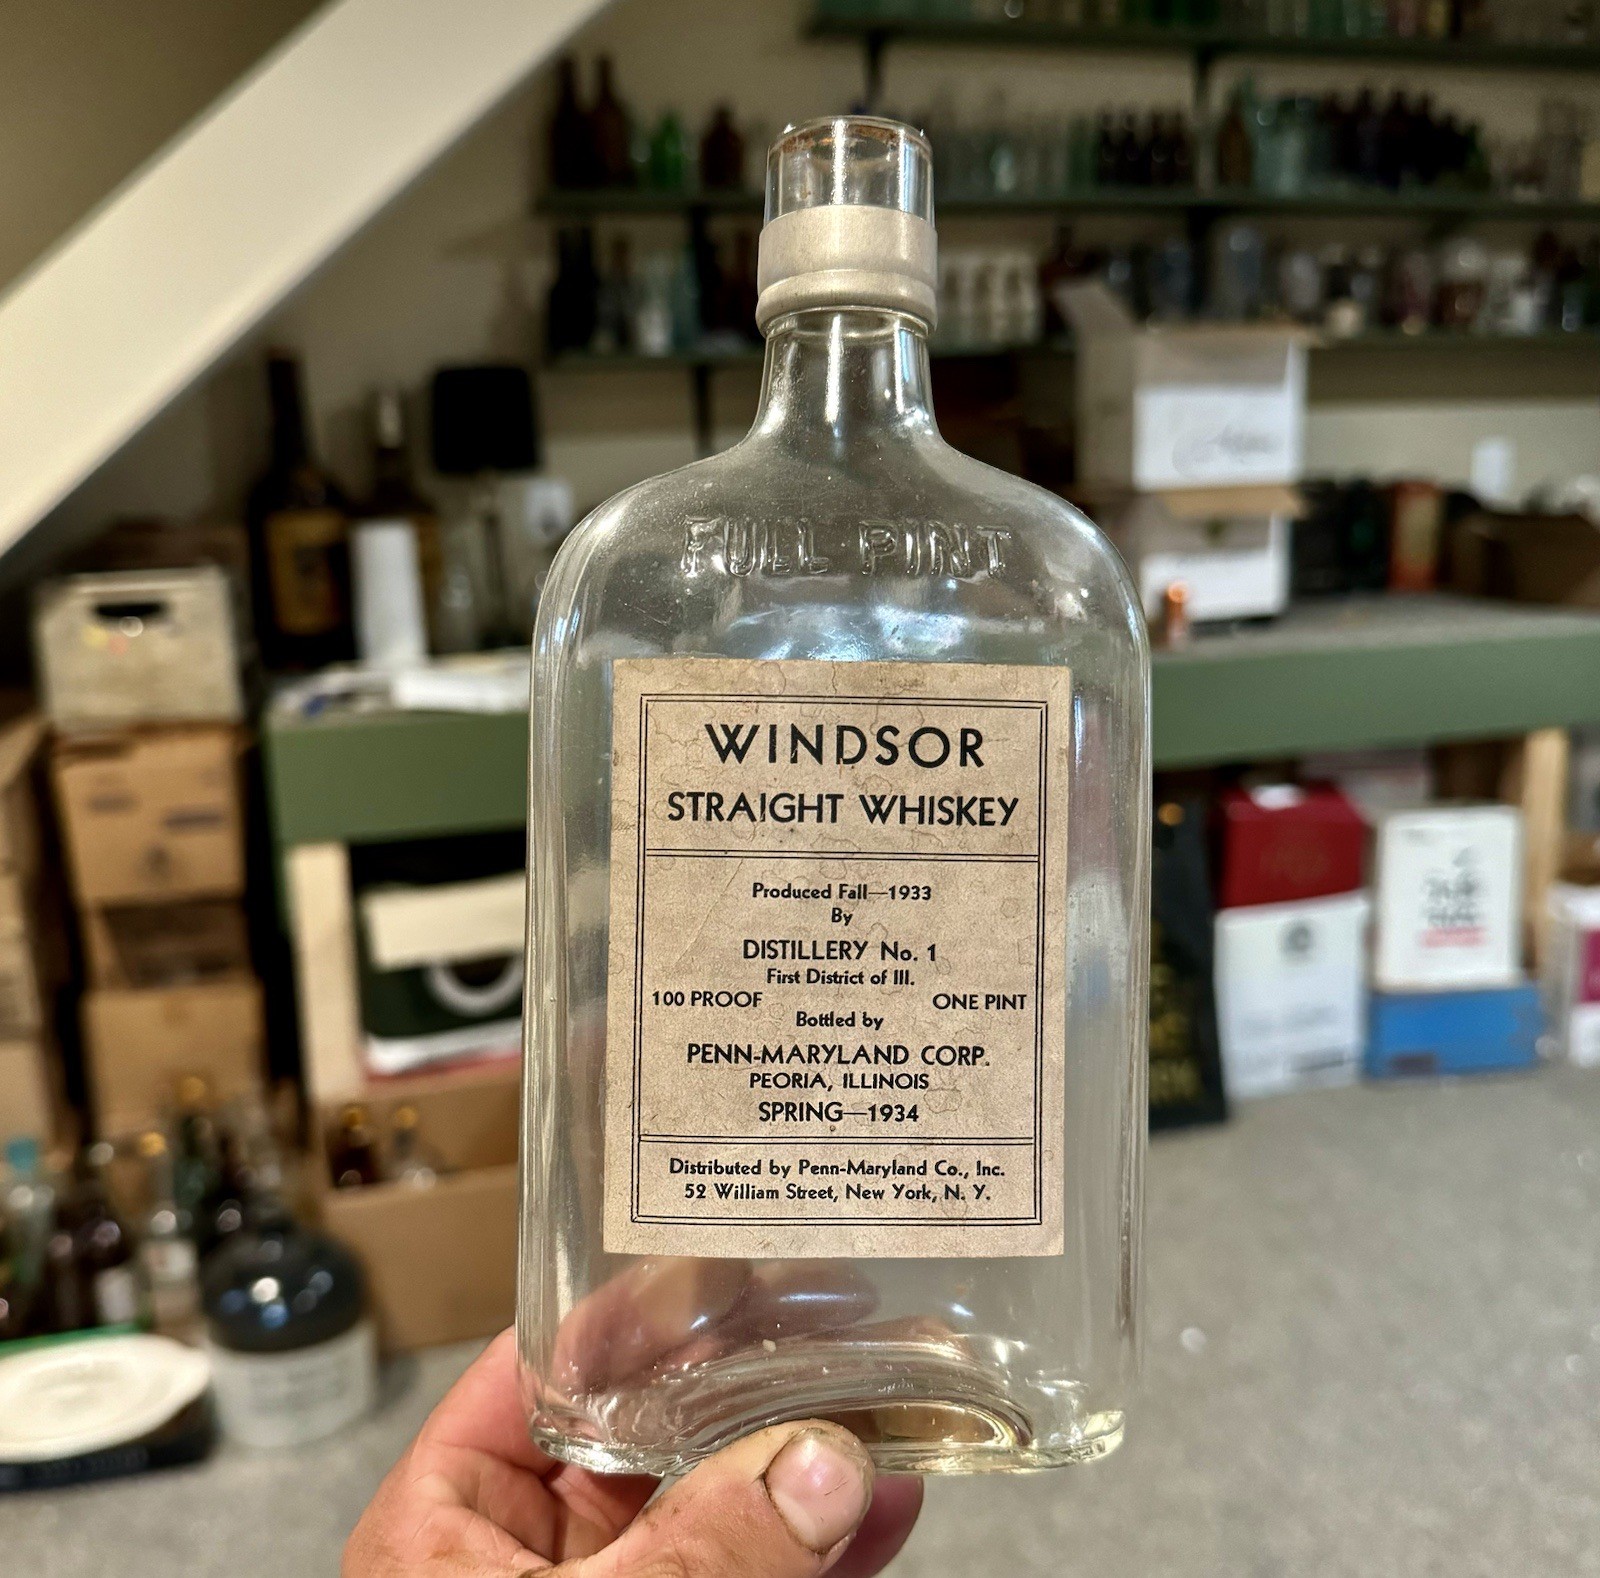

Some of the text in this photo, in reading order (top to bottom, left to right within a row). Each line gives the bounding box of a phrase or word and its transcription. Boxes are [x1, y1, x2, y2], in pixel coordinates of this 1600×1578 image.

[681, 516, 1012, 579] FULL PINT
[704, 722, 985, 770] WINDSOR
[667, 791, 1019, 827] STRAIGHT WHISKEY
[752, 882, 832, 900] Produced
[831, 907, 854, 927] By
[743, 939, 936, 962] DISTILLERY No. 1
[766, 967, 801, 985] First
[806, 968, 865, 985] District
[870, 969, 888, 985] of
[652, 990, 763, 1008] 100 PROOF
[932, 993, 1028, 1011] ONE PINT
[795, 1010, 885, 1031] Bottled by
[687, 1042, 990, 1067] PENN-MARYLAND CORP.
[749, 1072, 930, 1092] PEORIA, ILLINOIS
[669, 1157, 1005, 1180] Distributed by Penn-Maryland Co., Inc.
[684, 1182, 991, 1203] 52 William Street, New York, N. Y.
